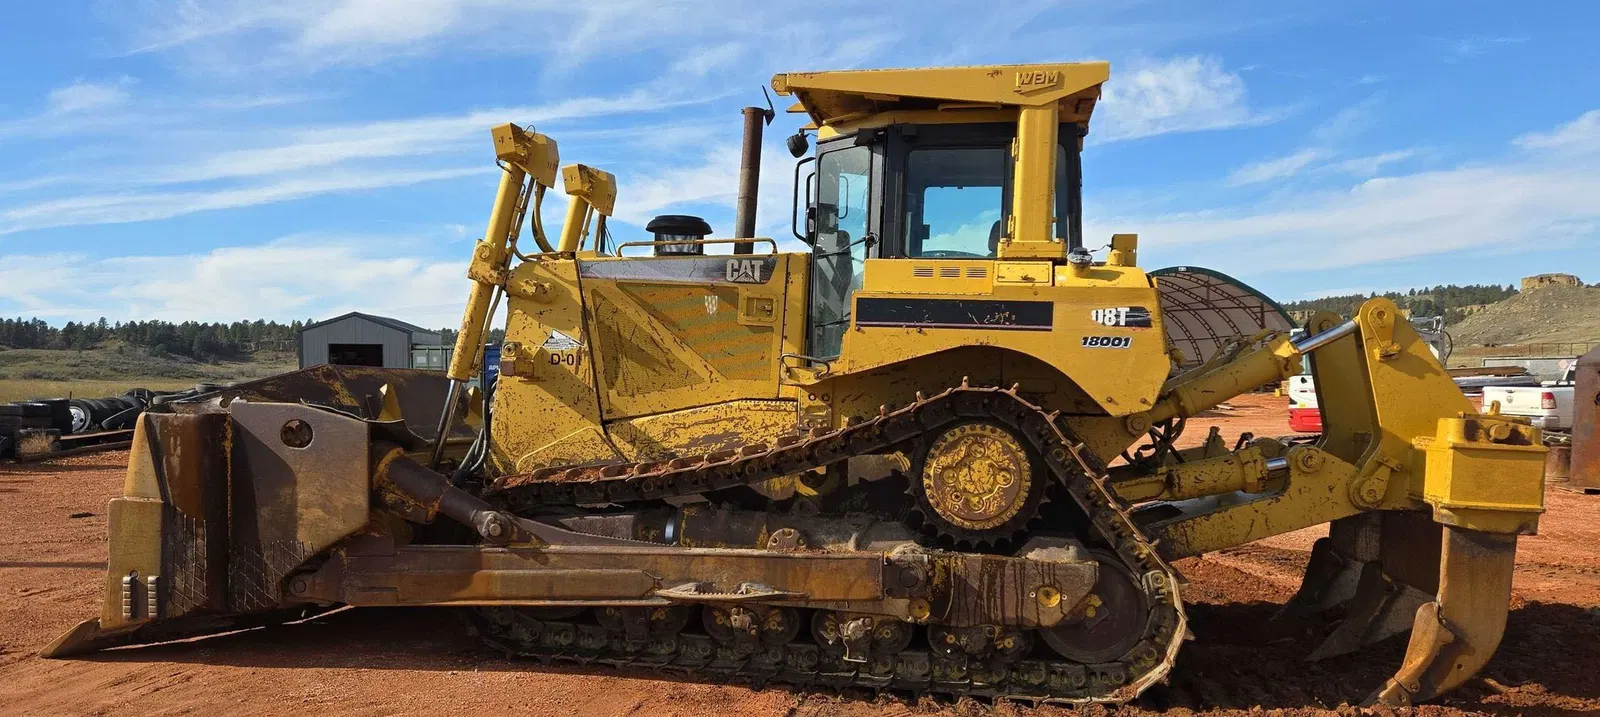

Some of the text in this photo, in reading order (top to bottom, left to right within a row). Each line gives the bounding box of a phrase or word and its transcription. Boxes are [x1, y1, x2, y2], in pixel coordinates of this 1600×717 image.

[1015, 70, 1060, 87] WBM
[726, 259, 764, 282] CAT
[1081, 336, 1132, 348] 18001
